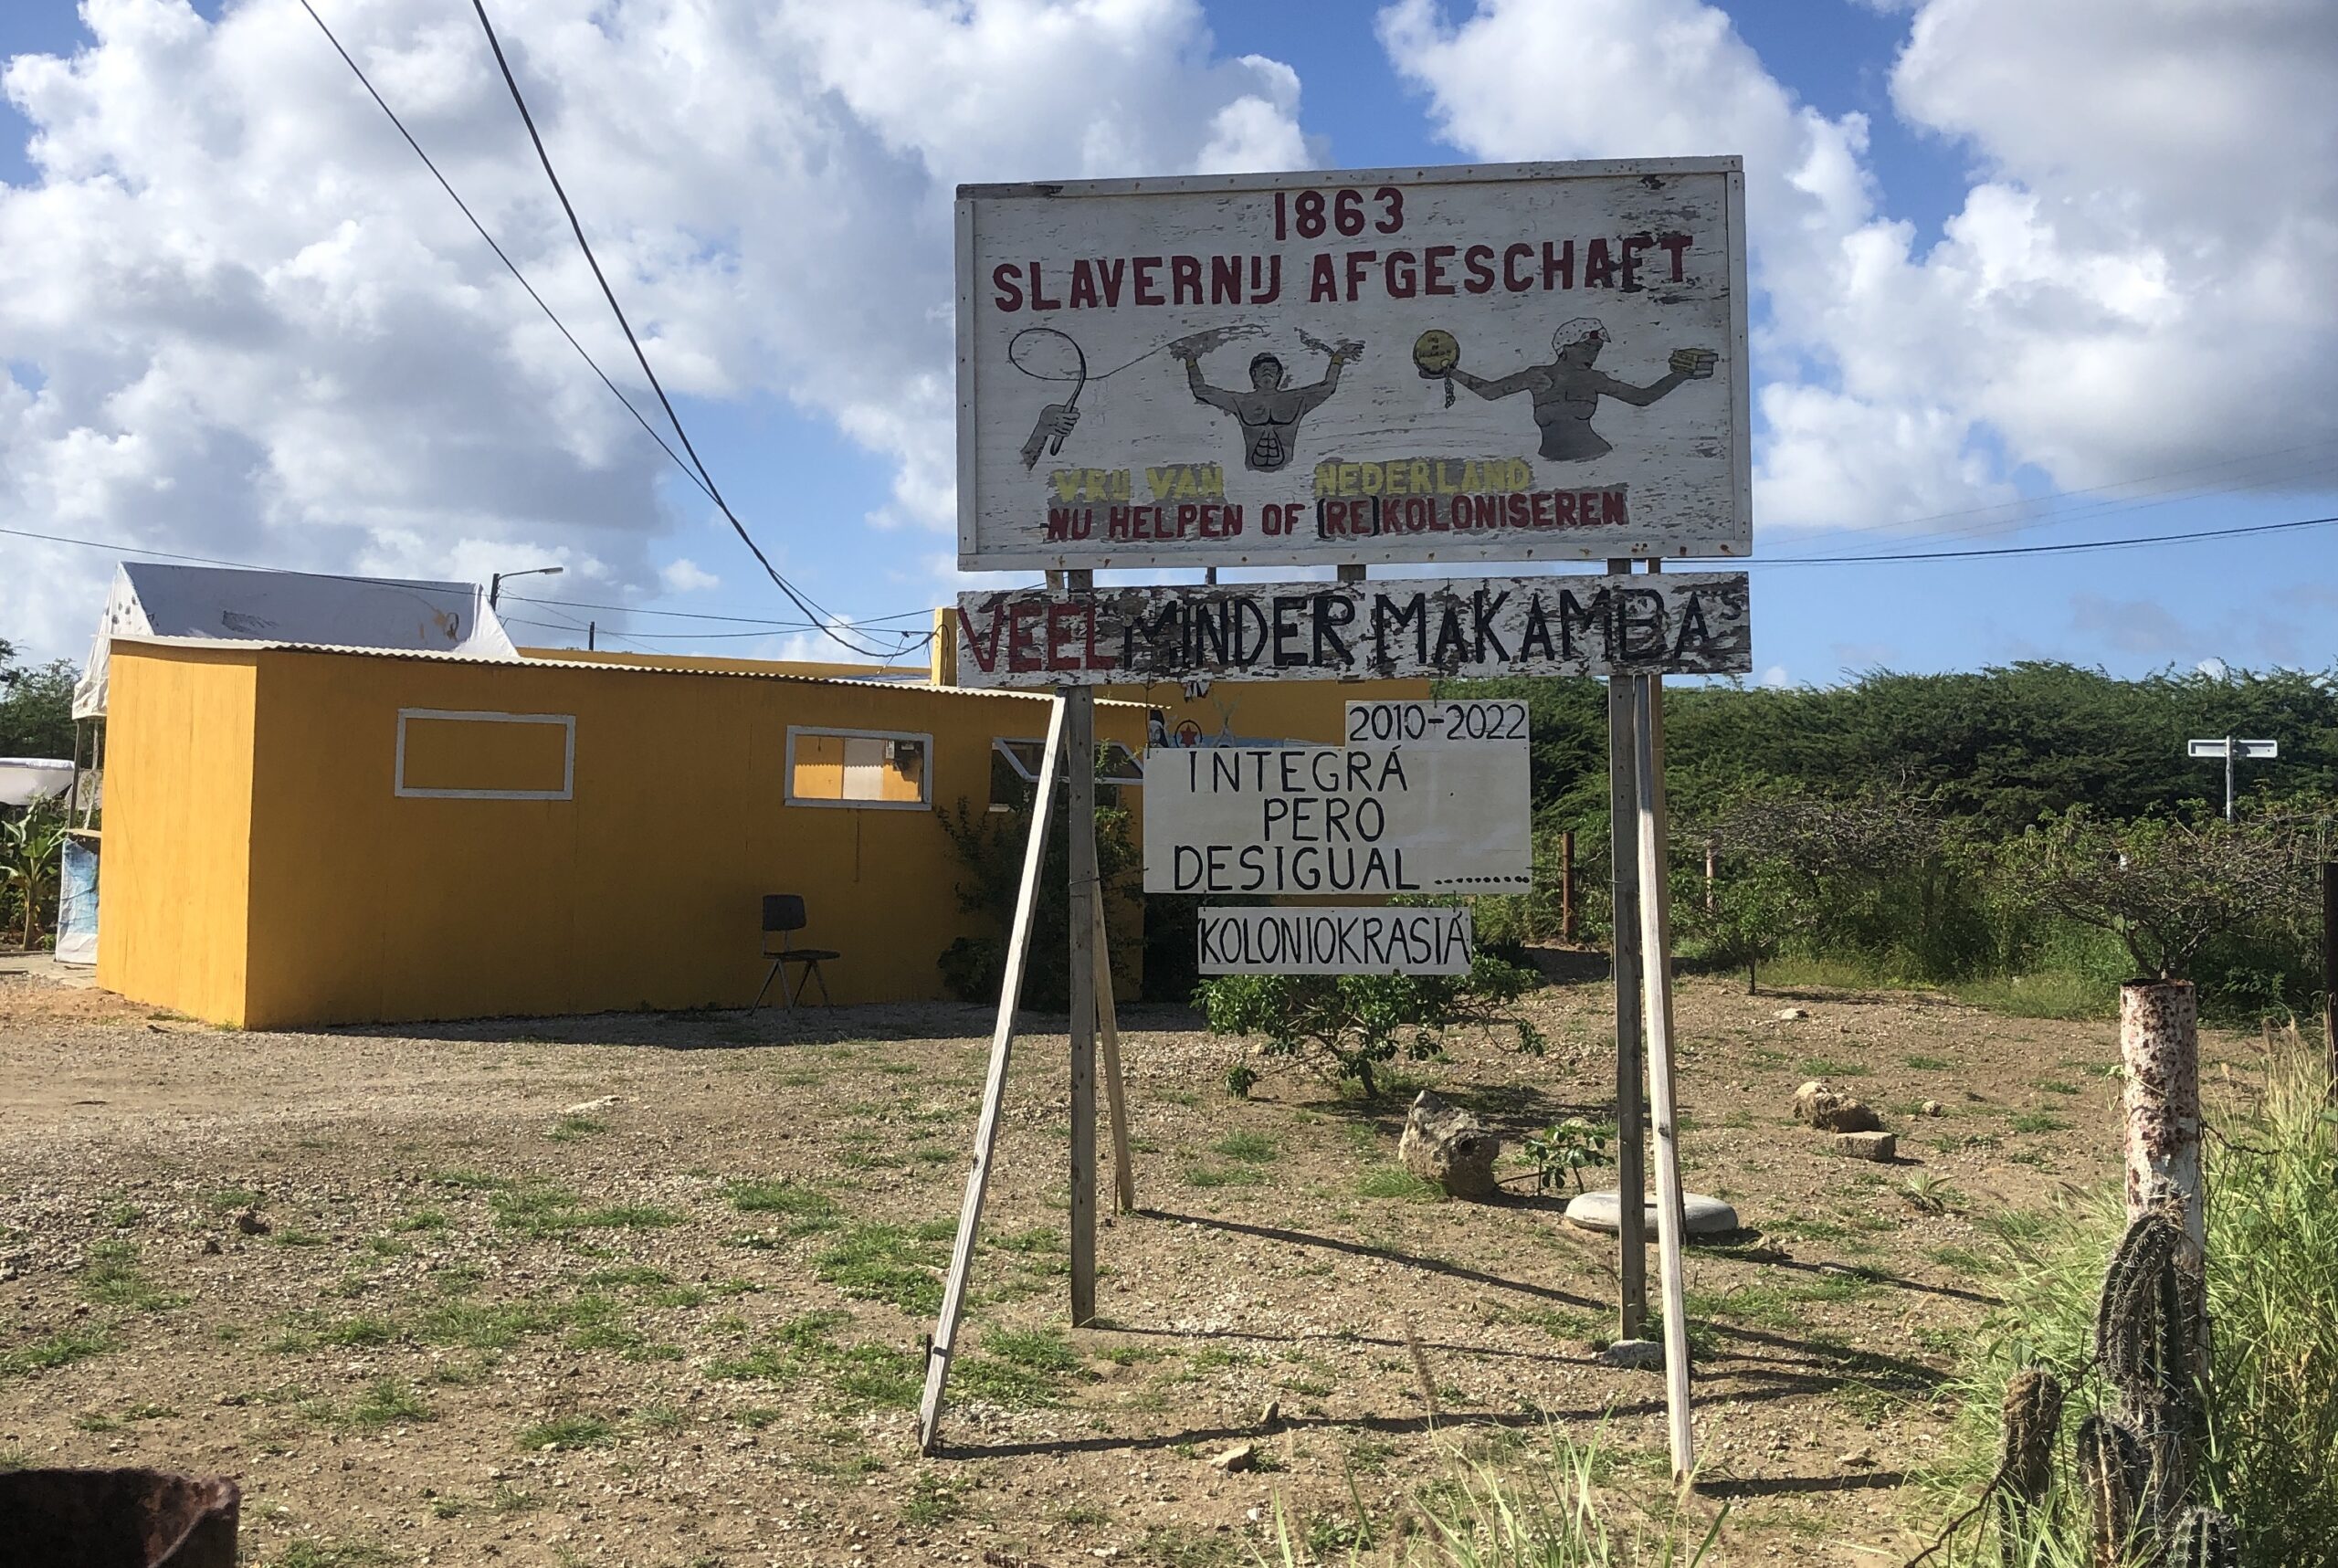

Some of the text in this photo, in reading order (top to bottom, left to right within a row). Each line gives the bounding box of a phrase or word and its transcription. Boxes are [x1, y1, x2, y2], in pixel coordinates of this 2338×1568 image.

[1275, 187, 1404, 241] 1863
[993, 235, 1693, 312] SLAVERNIJ AFGESCHAFT
[1145, 466, 1224, 500] VAN
[1315, 459, 1529, 495] NEDERLAND
[1048, 508, 1092, 541] NU
[1109, 504, 1243, 539] HELPEN
[1262, 503, 1305, 536] OF
[959, 603, 1116, 672] VEEL
[1123, 595, 1355, 668] MINDER
[1349, 704, 1526, 742] 2010-2022
[1189, 745, 1408, 793] INTEGRÁ
[1264, 797, 1385, 843] PERO
[1174, 846, 1420, 890] DESIGUAL
